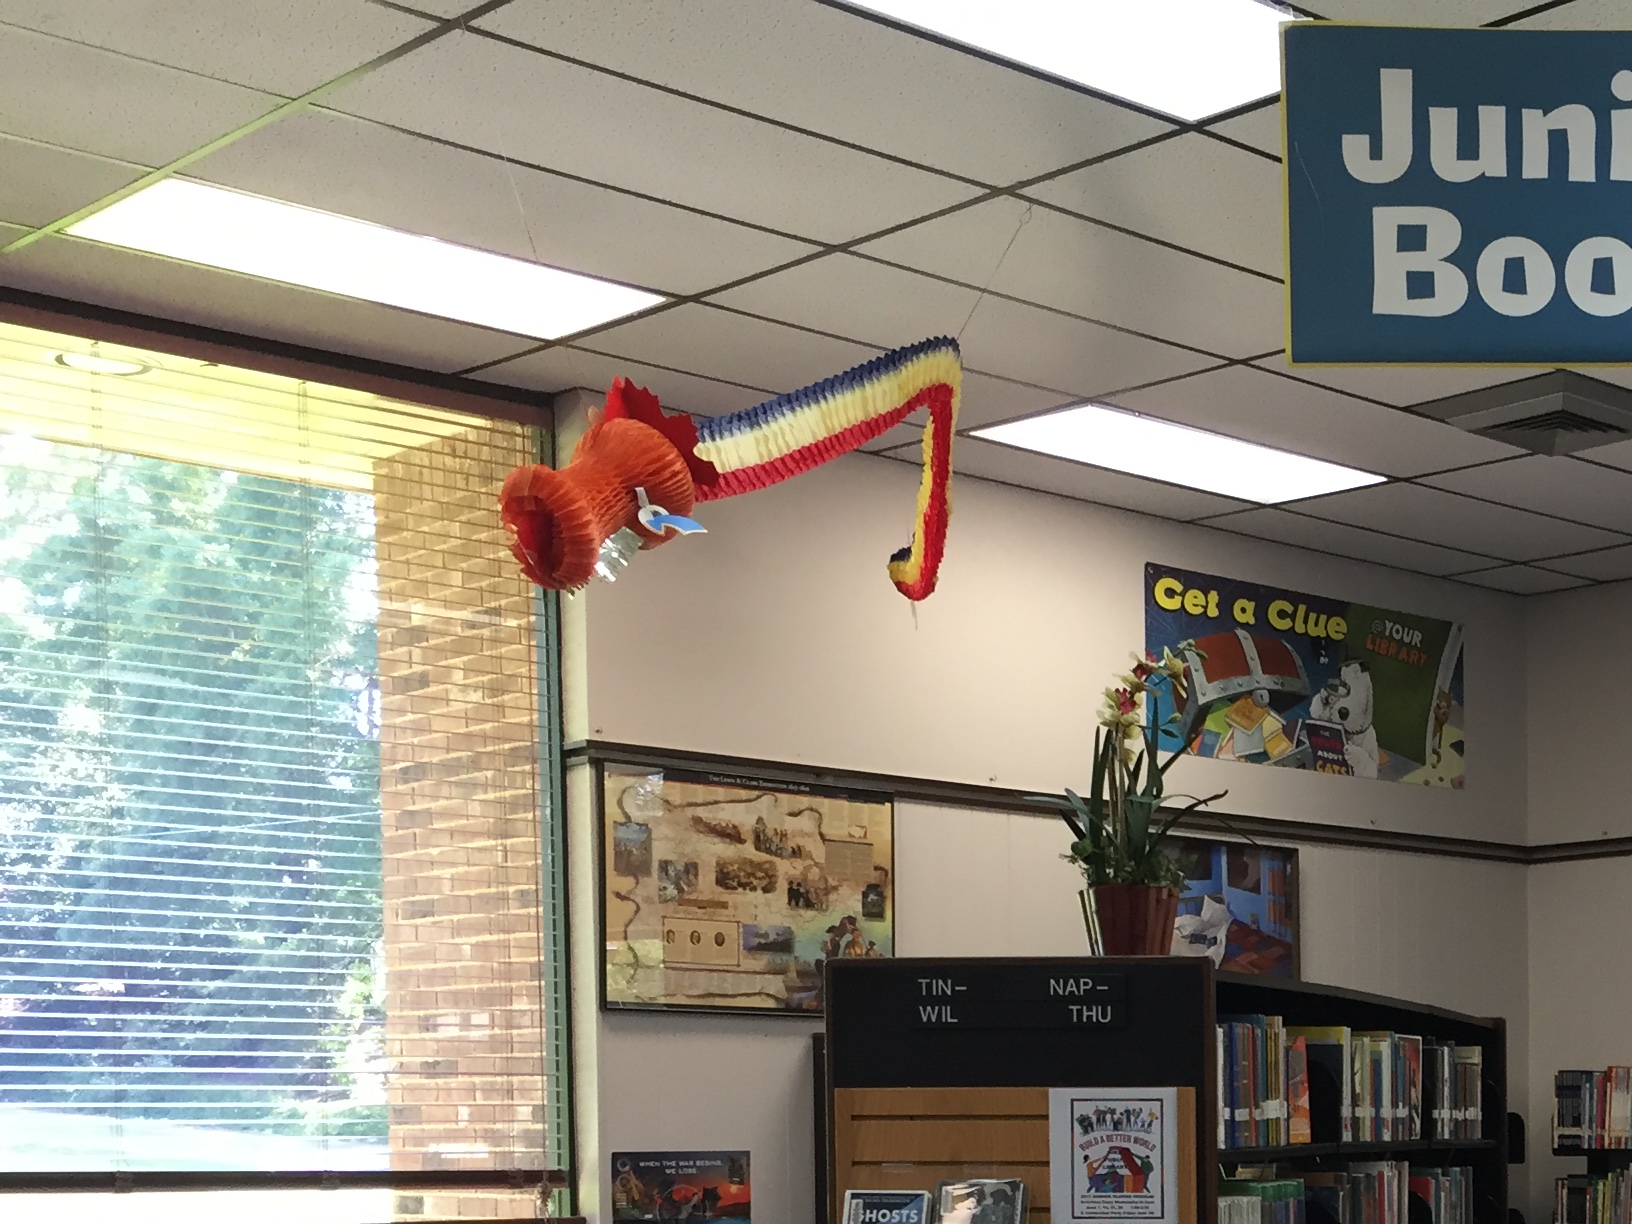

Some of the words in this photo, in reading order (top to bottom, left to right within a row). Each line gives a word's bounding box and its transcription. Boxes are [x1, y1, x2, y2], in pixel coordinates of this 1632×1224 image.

[1154, 577, 1219, 618] Get
[1233, 598, 1256, 626] a
[1267, 599, 1348, 641] Clue
[1366, 634, 1429, 666] LIBRARY
[918, 978, 967, 996] TIN-
[1050, 978, 1108, 996] NAP-
[919, 1006, 958, 1023] WIL
[1068, 1006, 1112, 1023] THU
[863, 1208, 919, 1223] HOSTS
